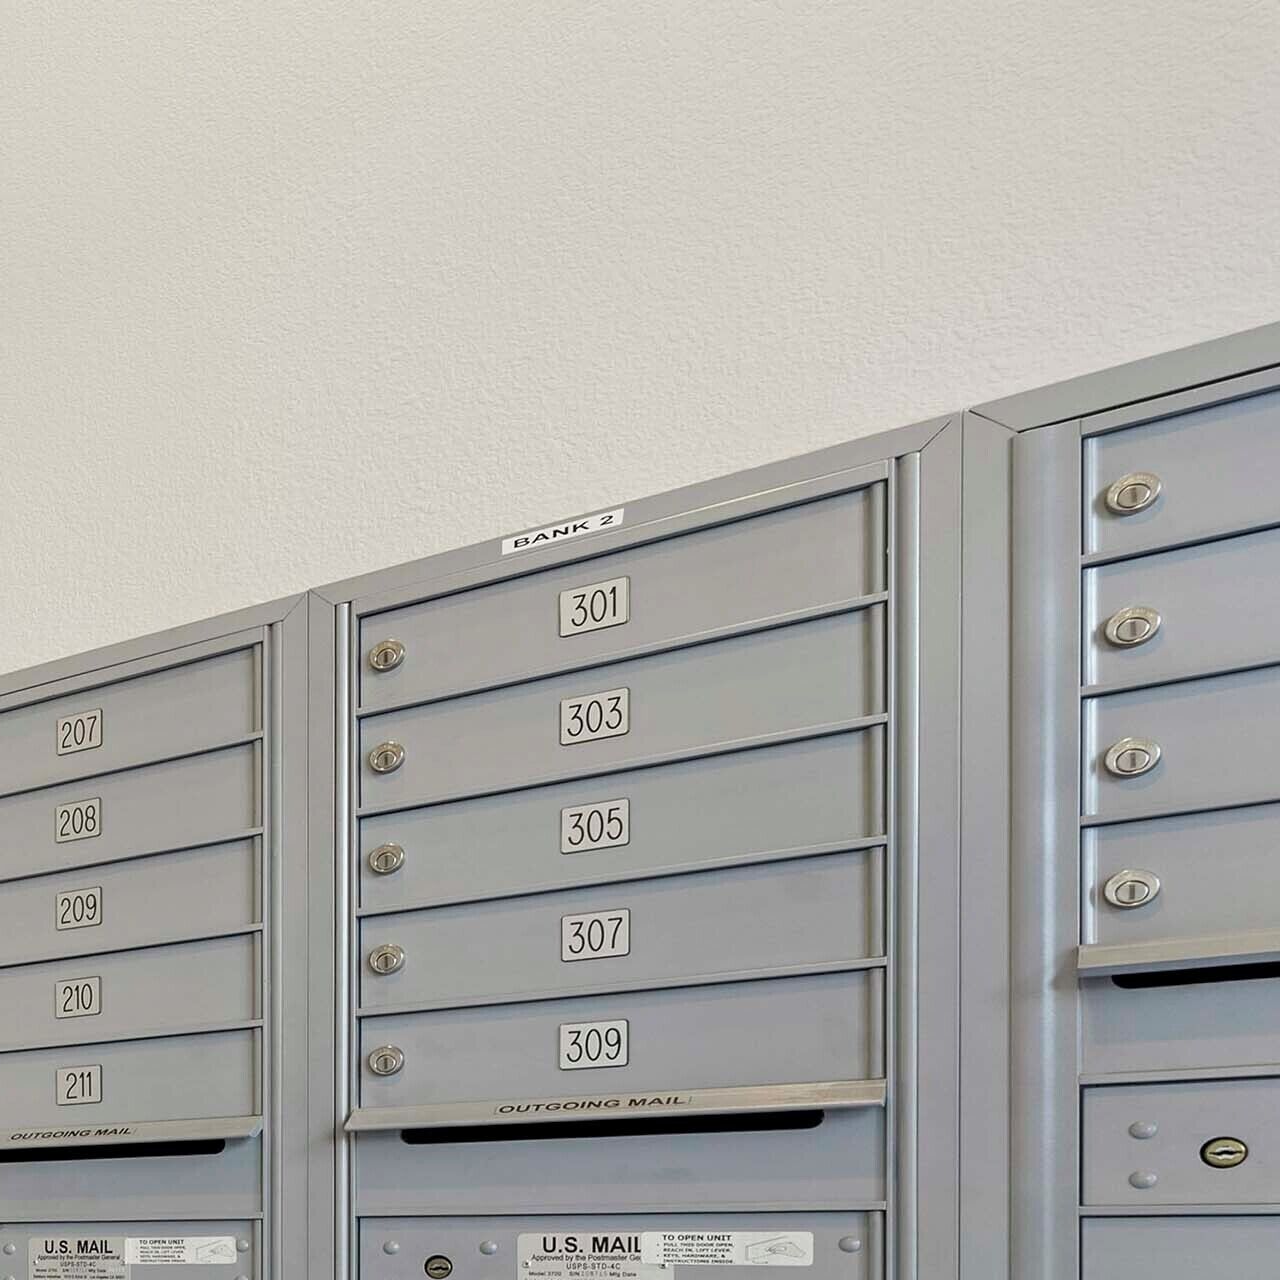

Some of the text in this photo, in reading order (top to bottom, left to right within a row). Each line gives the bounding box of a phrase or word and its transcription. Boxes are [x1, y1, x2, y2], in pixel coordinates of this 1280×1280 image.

[513, 514, 615, 549] BANK 2
[571, 586, 617, 627] 301
[61, 715, 97, 749] 207
[567, 696, 623, 737] 303
[59, 804, 96, 837] 208
[567, 807, 623, 846] 305
[60, 893, 97, 925] 209
[568, 916, 623, 954] 307
[62, 983, 93, 1013] 210
[566, 1027, 622, 1063] 309
[66, 1071, 92, 1100] 211
[498, 1095, 686, 1114] OUTGOING MAIL
[10, 1127, 131, 1141] OUTGOING MAIL
[44, 1239, 113, 1254] U.S. MAIL
[531, 1254, 564, 1263] Approved
[565, 1254, 574, 1263] by
[587, 1254, 628, 1262] Postmaster
[542, 1236, 642, 1254] U.S. MAIL
